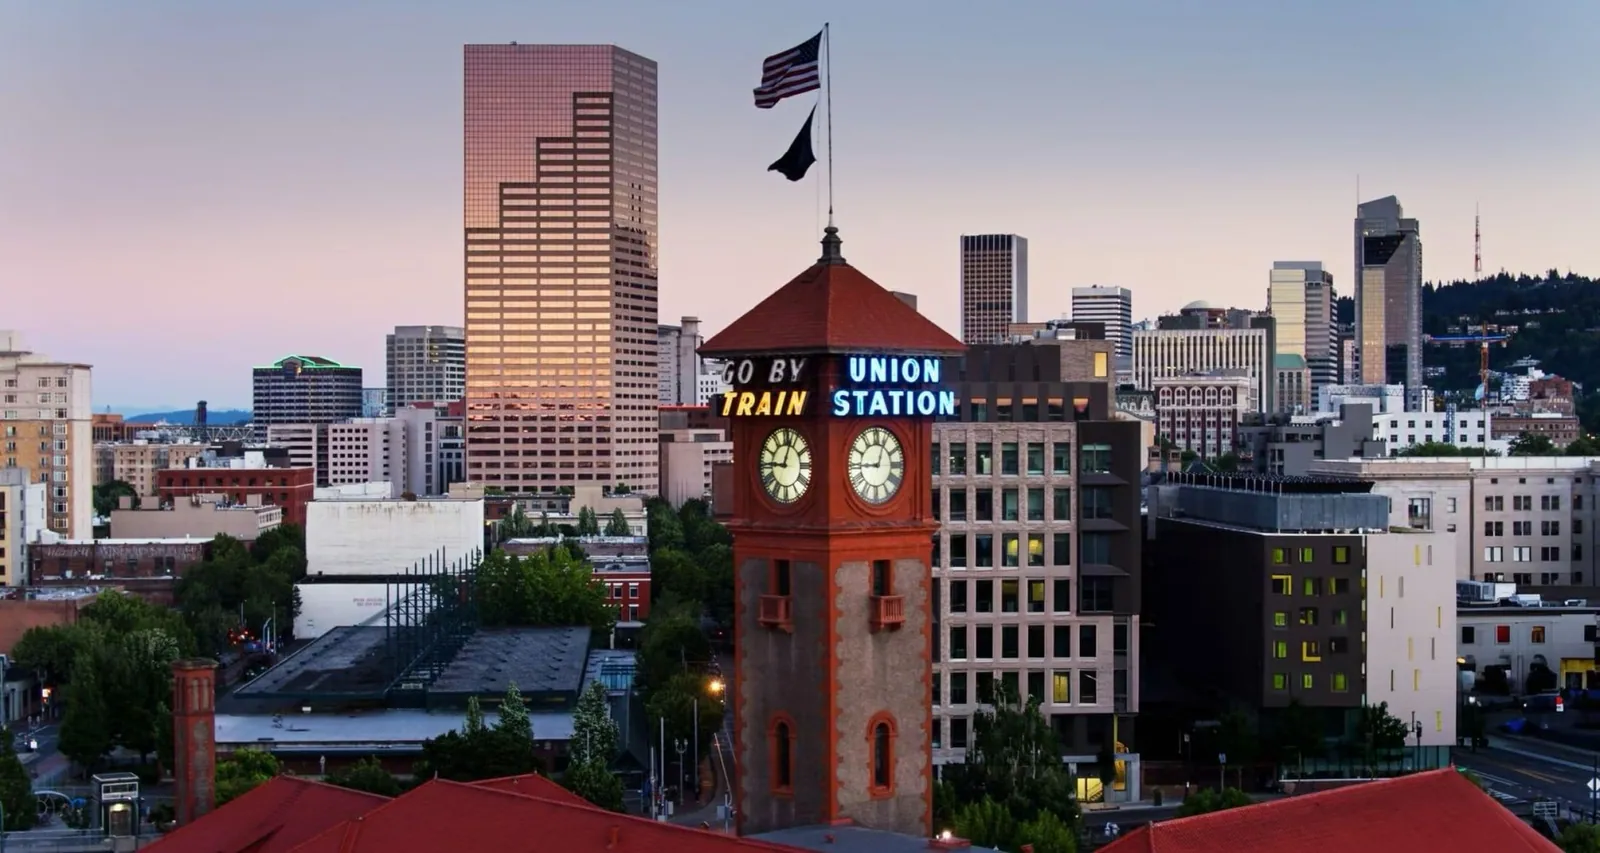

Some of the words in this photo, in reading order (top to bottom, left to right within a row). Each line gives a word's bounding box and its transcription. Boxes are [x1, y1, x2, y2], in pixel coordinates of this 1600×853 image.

[722, 359, 754, 384] GO
[768, 358, 807, 383] BY
[849, 357, 940, 383] UNION
[721, 390, 808, 416] TRAIN
[833, 389, 955, 416] STATION
